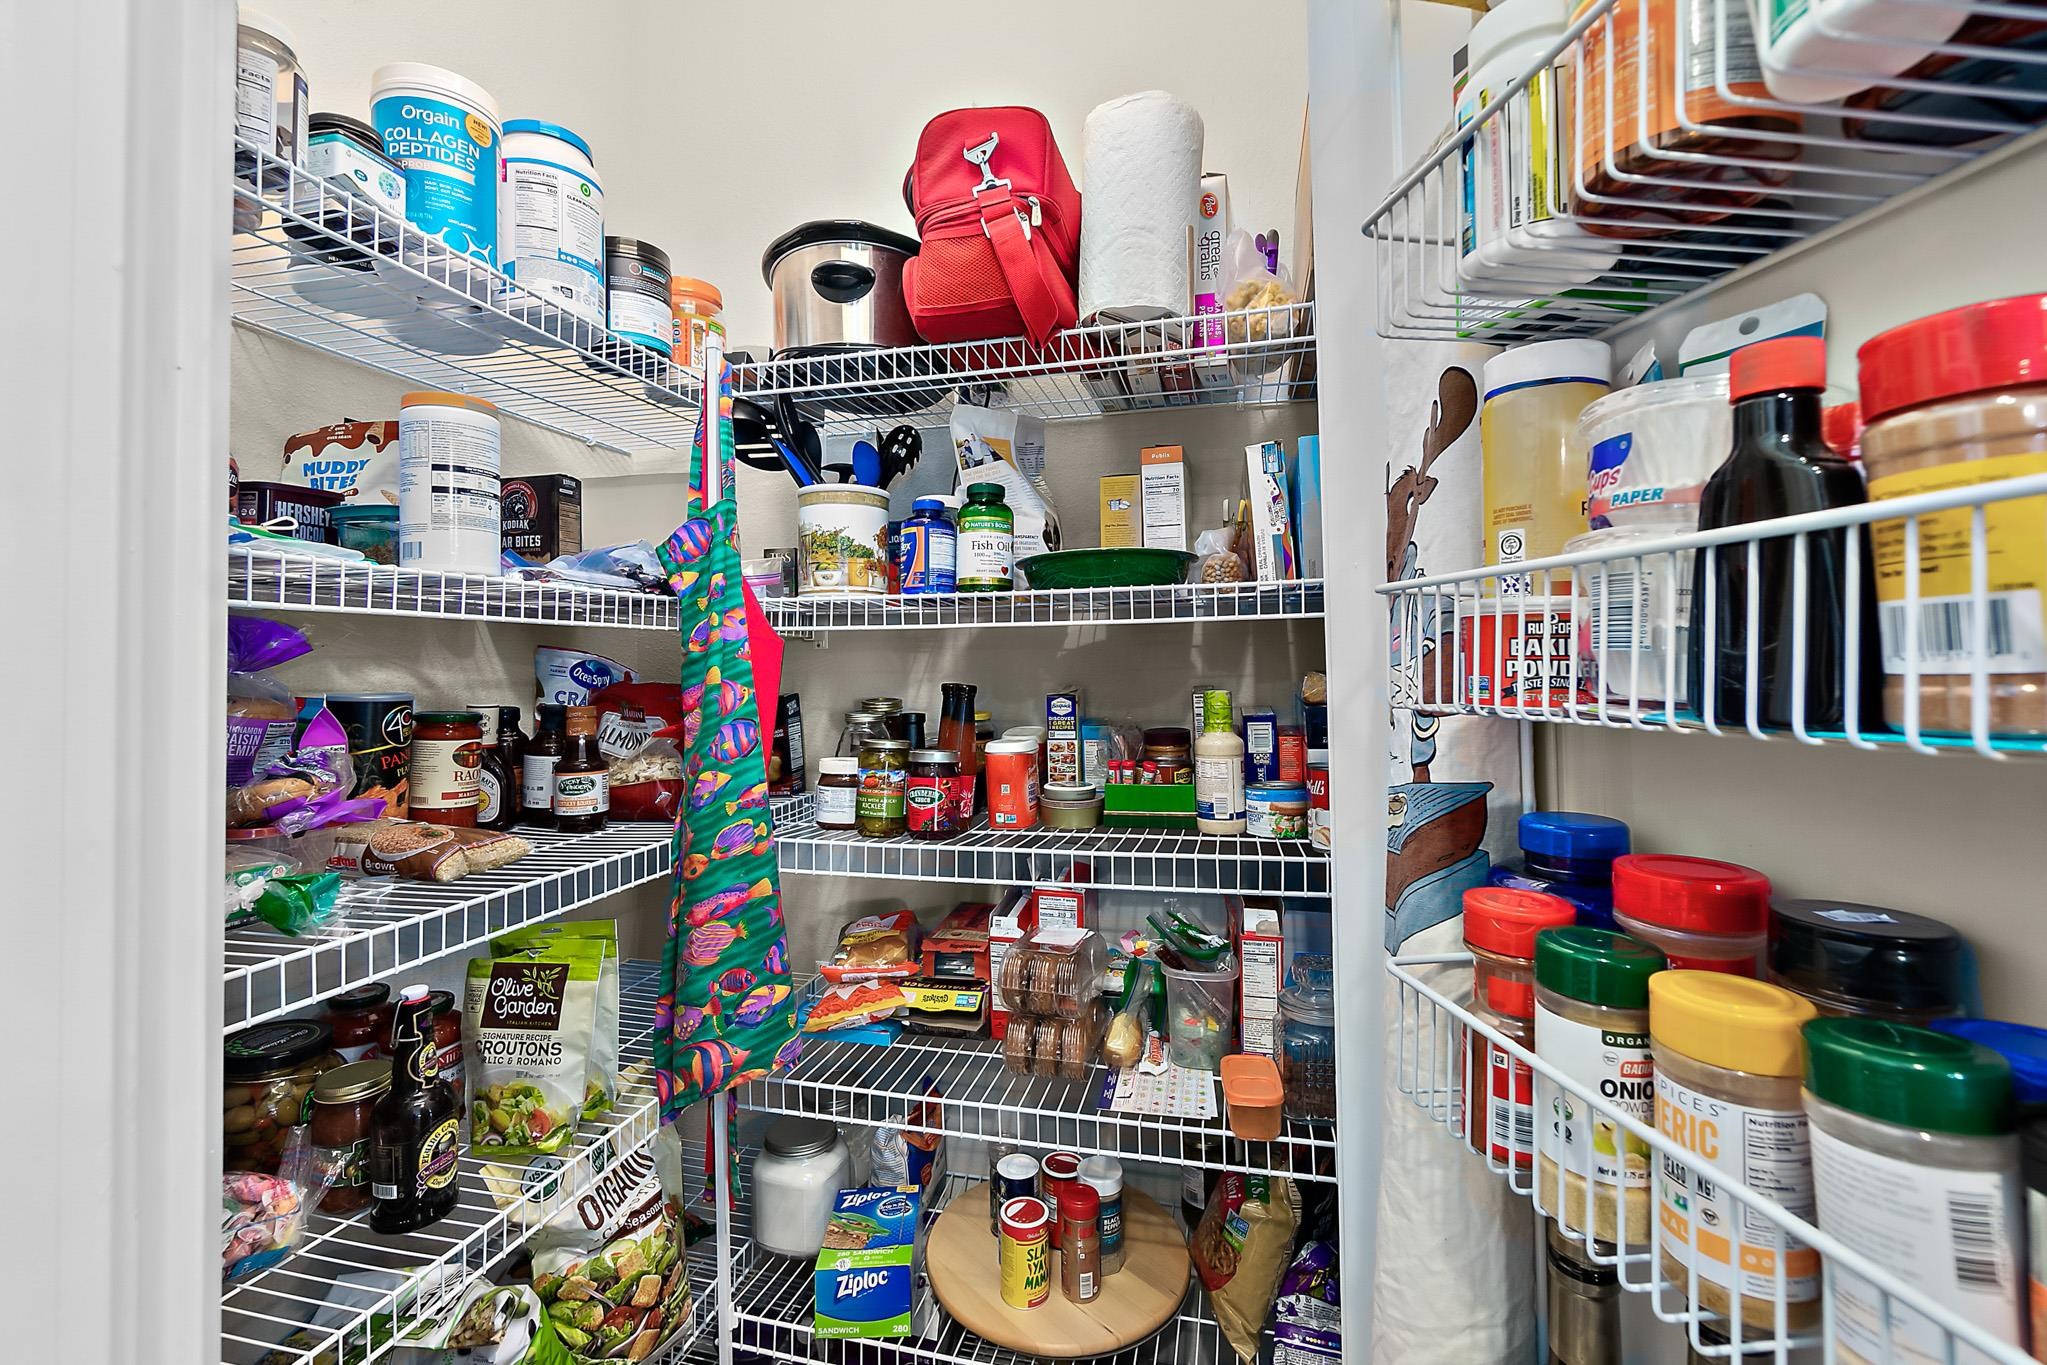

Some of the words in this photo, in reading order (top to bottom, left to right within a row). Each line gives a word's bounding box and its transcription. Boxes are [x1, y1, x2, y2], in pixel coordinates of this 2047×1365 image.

[241, 68, 271, 83] Facts
[401, 105, 460, 130] Orgain
[385, 127, 480, 160] COLLAGEN
[389, 142, 475, 172] PEPTIDES
[303, 458, 371, 477] MUDDY
[310, 473, 358, 490] BITES
[1611, 487, 1664, 506] PAPER
[502, 519, 529, 531] KODIAK
[971, 521, 995, 529] NATURE'S
[501, 536, 513, 548] AR
[515, 535, 541, 548] BITES
[971, 540, 993, 551] Fish
[996, 541, 1010, 553] Oil
[1528, 622, 1572, 634] RUFOR
[1510, 638, 1573, 656] BAKI
[574, 667, 592, 684] Ocea
[599, 725, 650, 751] ALMOND
[227, 744, 257, 757] EMIX
[380, 750, 411, 770] PAN
[454, 768, 481, 782] RAO
[365, 858, 396, 871] Brown
[491, 977, 533, 997] Olive
[494, 996, 557, 1019] Garden
[482, 1032, 525, 1041] SIGNATURE
[525, 1033, 552, 1042] RECIPE
[1606, 1034, 1650, 1046] ORGAN
[476, 1040, 562, 1056] CROUTONS
[482, 1056, 504, 1065] RLIC
[507, 1057, 513, 1065] &
[516, 1057, 561, 1066] ROMANO
[1600, 1079, 1654, 1100] ONIO
[1609, 1100, 1654, 1114] POWDE
[1657, 1096, 1719, 1161] ERIC
[1748, 1118, 1796, 1129] Nutrition
[840, 1191, 891, 1209] Ziploc
[626, 1199, 664, 1229] Seasone
[853, 1248, 894, 1256] SANDWICH
[836, 1269, 888, 1299] Ziploc
[817, 1326, 860, 1335] SANDWICH
[892, 1324, 909, 1333] 280
